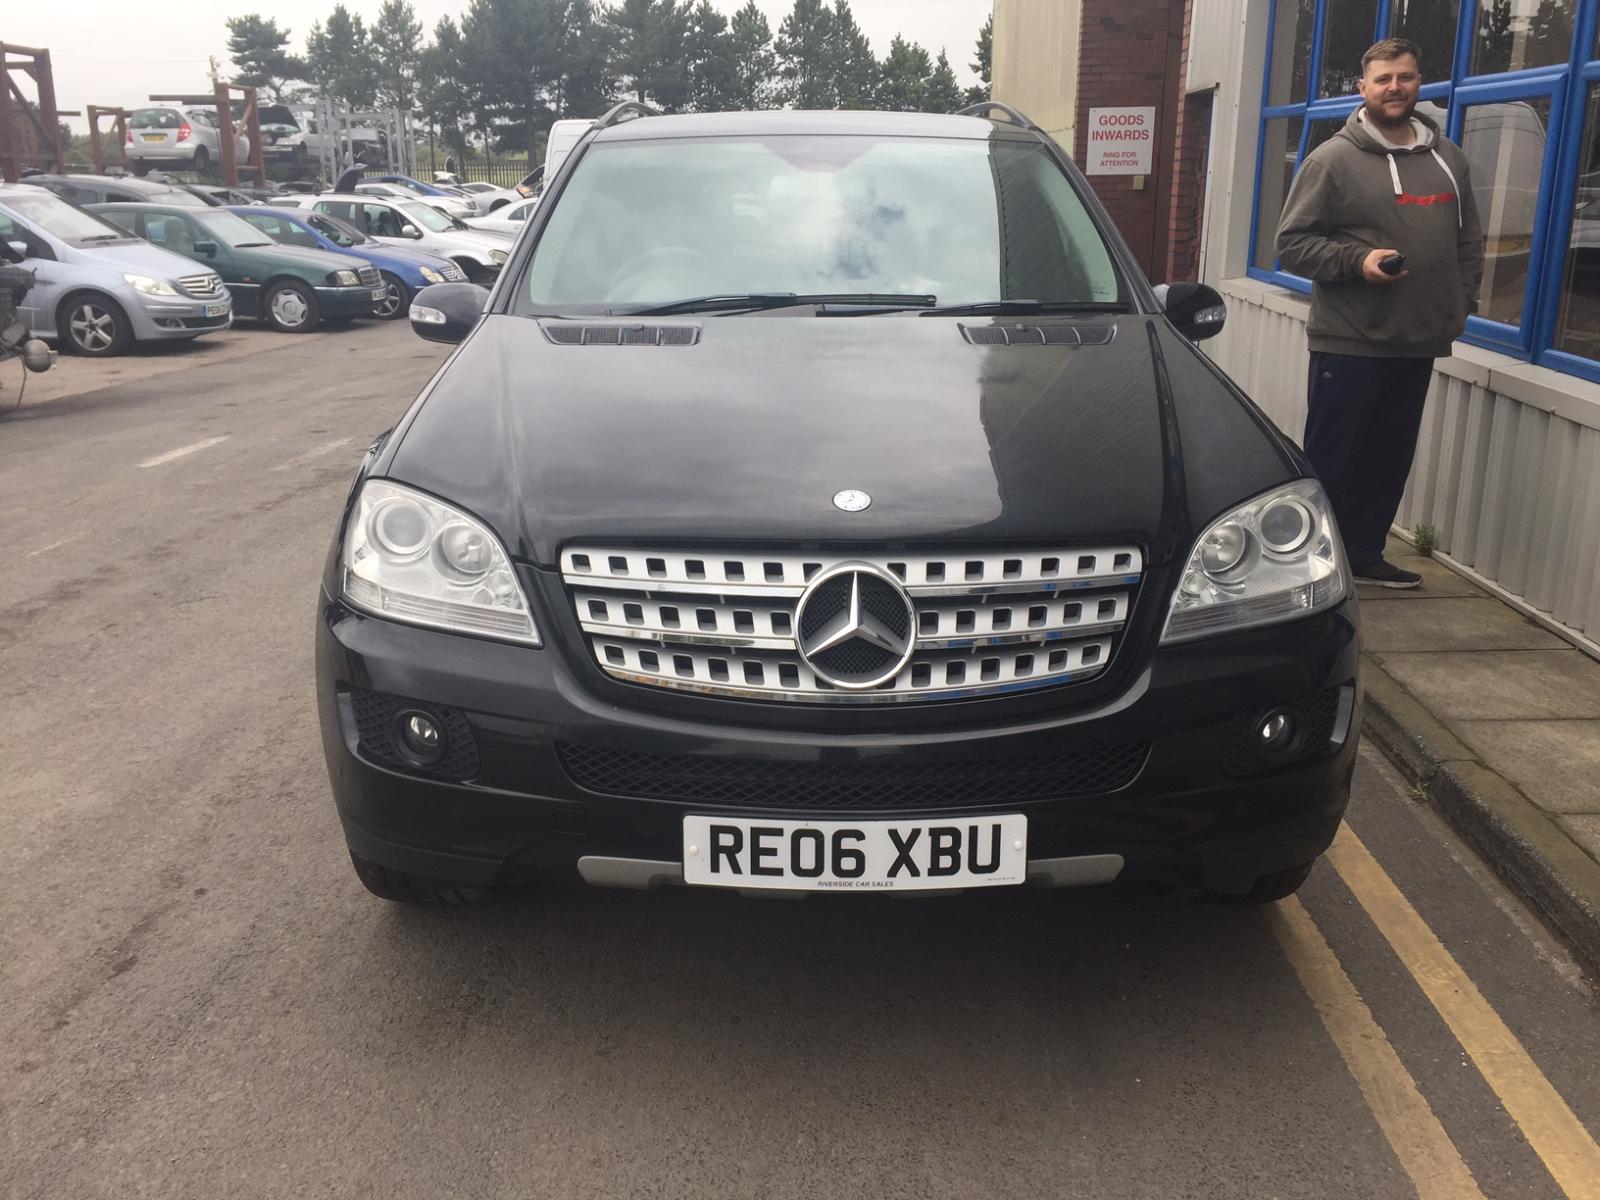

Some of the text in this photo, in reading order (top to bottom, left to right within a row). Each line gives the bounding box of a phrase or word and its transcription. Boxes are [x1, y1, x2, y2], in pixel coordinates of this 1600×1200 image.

[1099, 115, 1144, 126] GOODS
[1092, 130, 1150, 141] INWARDS
[709, 823, 1002, 878] RE06 XBU
